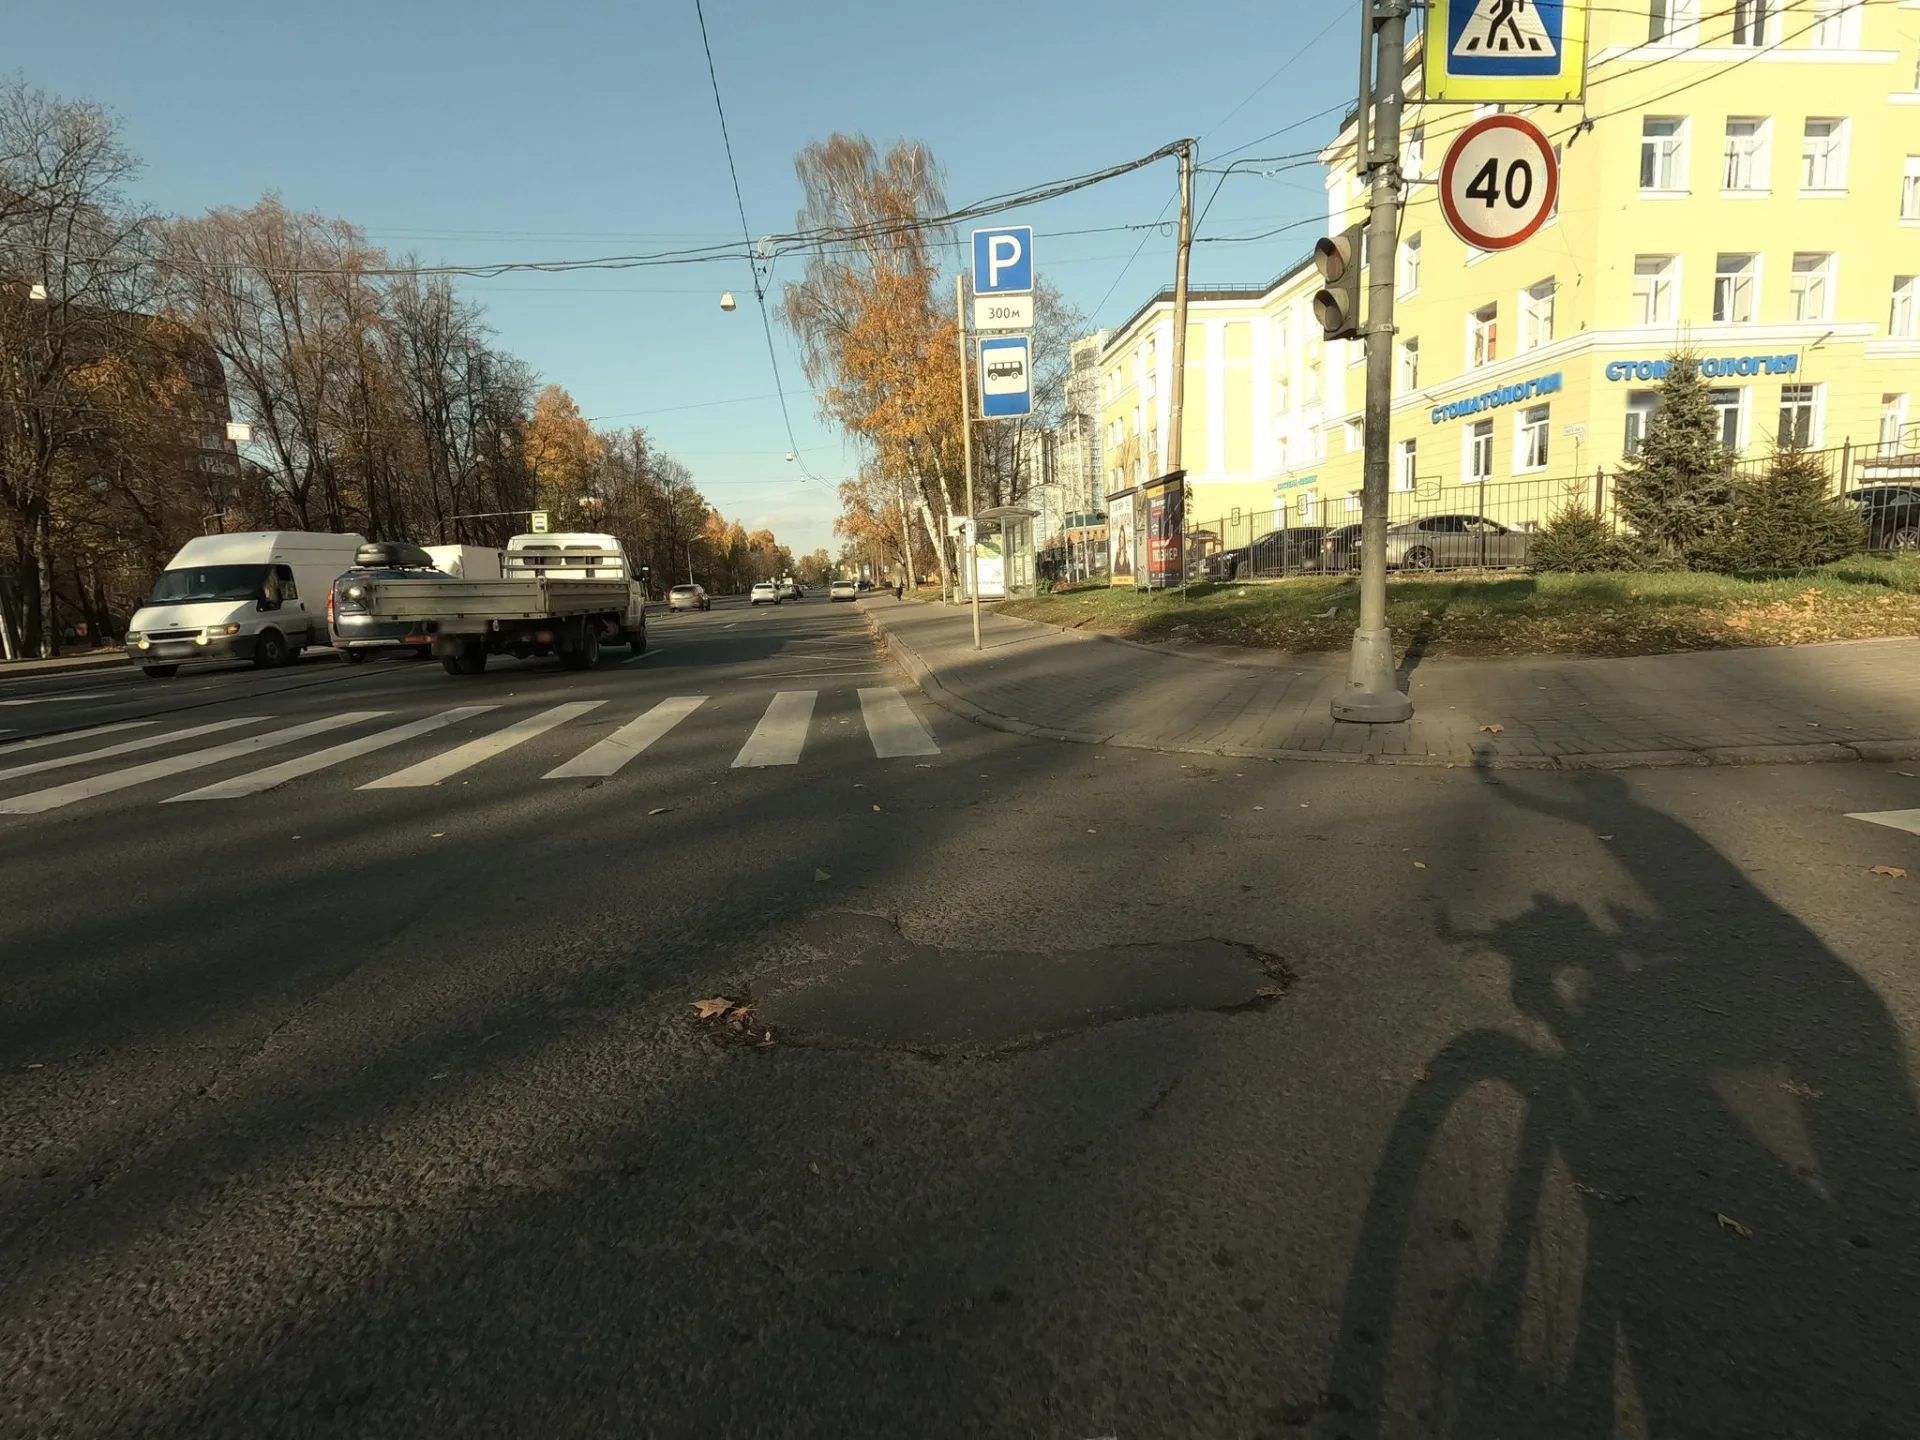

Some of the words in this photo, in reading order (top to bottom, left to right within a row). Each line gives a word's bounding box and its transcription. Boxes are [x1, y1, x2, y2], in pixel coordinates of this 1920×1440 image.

[1465, 157, 1533, 209] 40
[988, 234, 1022, 287] P
[988, 306, 1021, 320] 300м
[1605, 354, 1798, 382] СТОМТОЛОГИЯ
